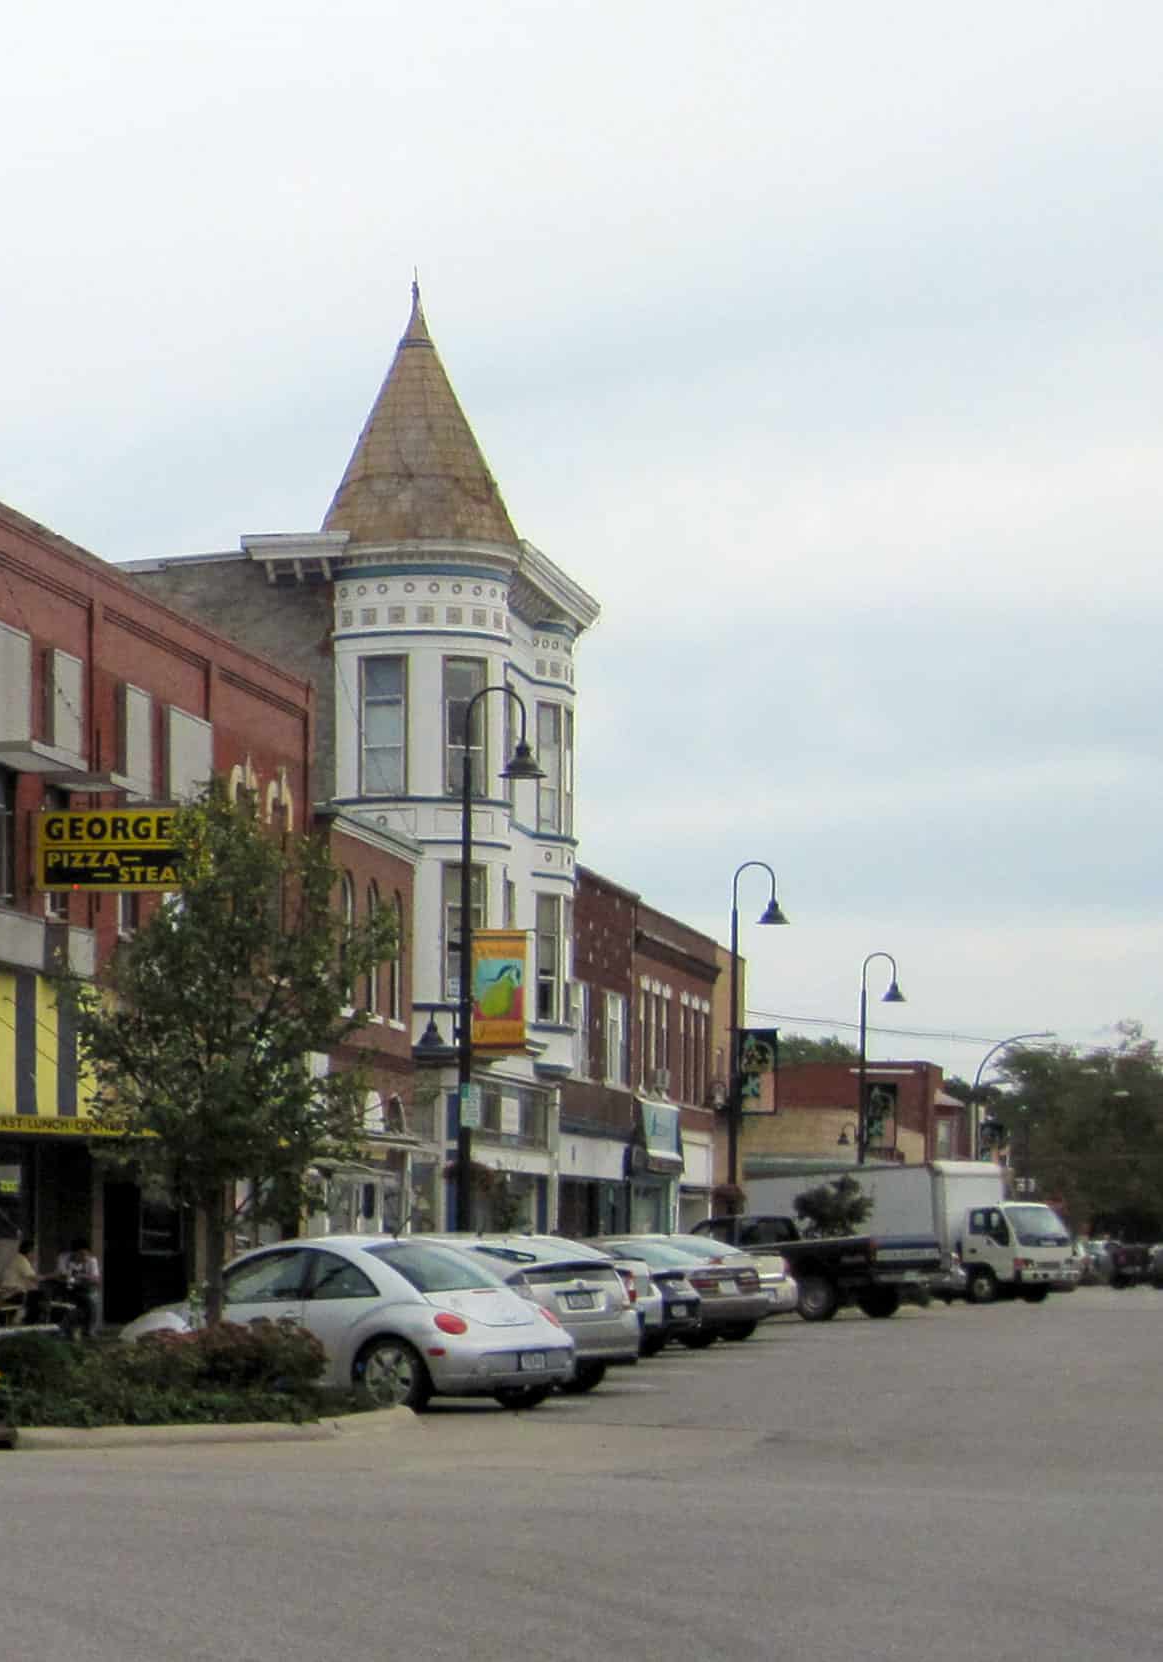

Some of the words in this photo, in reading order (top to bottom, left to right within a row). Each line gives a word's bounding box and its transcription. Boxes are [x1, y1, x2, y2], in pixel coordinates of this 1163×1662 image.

[47, 851, 121, 868] PIZZA
[117, 866, 180, 883] STEA
[28, 1117, 70, 1130] LUNCH
